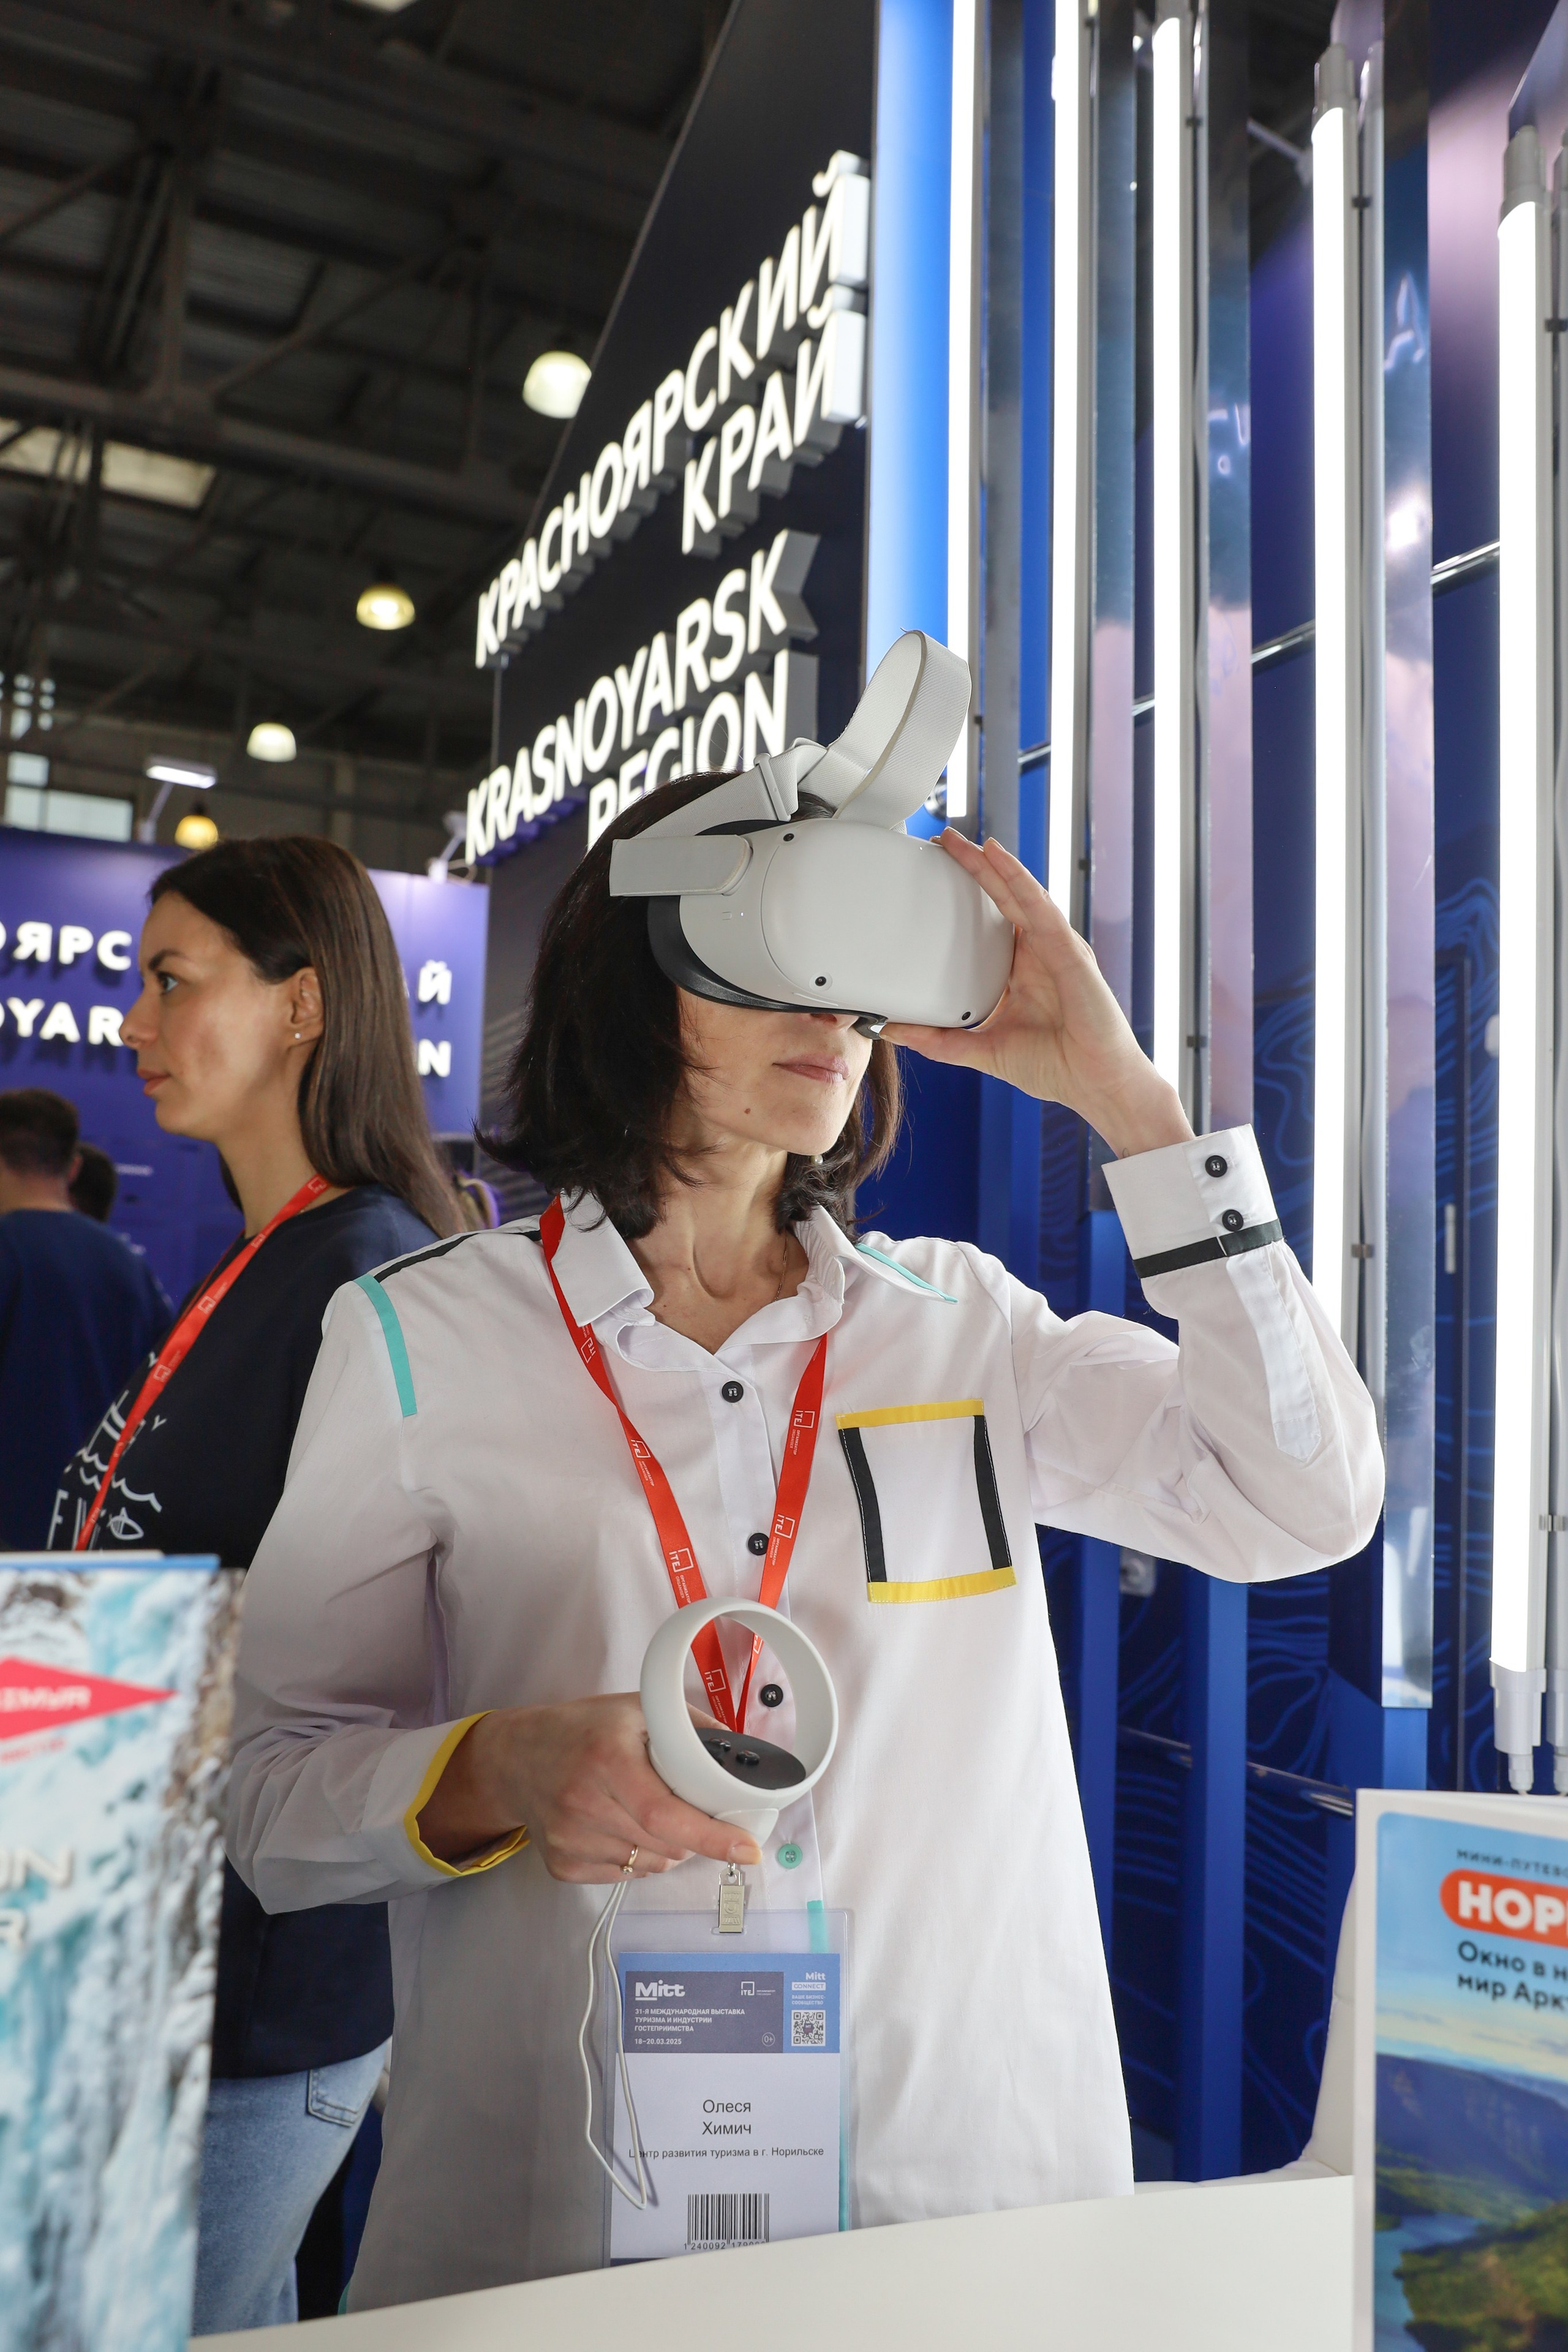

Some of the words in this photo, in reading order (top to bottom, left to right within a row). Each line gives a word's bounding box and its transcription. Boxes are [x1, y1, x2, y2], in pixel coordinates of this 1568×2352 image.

[475, 151, 850, 669] КРАСНОЯРСКИЙ
[682, 285, 842, 554] КРАЙ
[465, 528, 789, 865] KRASNOYARSK
[587, 648, 789, 850] REGION
[0, 921, 132, 971] ЯРС
[0, 997, 125, 1047] YAR
[1458, 1880, 1568, 1939] НОР
[805, 1972, 826, 1980] Mitt
[1458, 1940, 1525, 1973] Окно
[1533, 1962, 1545, 1977] в
[635, 1979, 686, 1998] Mitt
[1458, 1973, 1506, 2002] мир
[703, 2099, 752, 2113] Олеся
[702, 2121, 752, 2135] Химич
[662, 2149, 707, 2159] развития
[710, 2149, 750, 2158] туризма
[771, 2147, 824, 2157] Норильске
